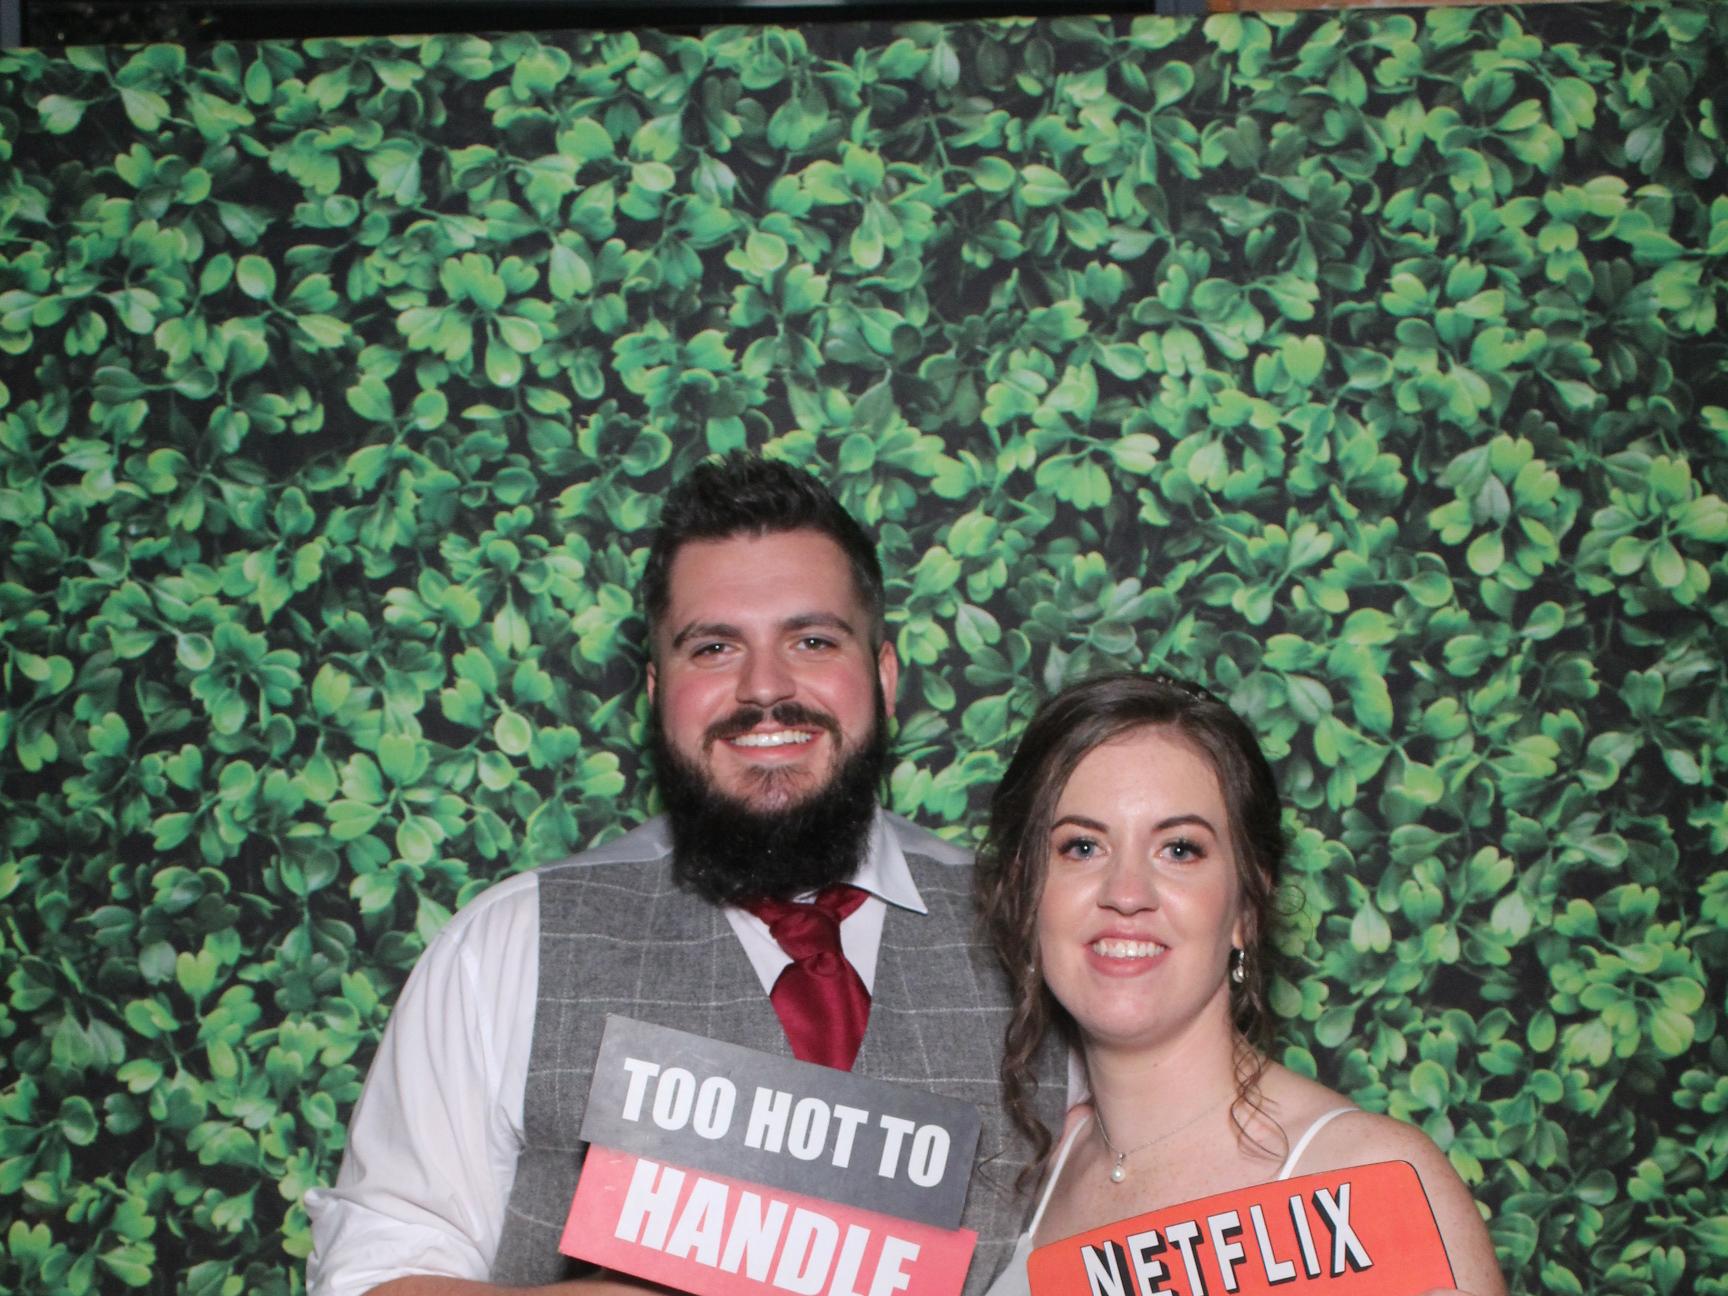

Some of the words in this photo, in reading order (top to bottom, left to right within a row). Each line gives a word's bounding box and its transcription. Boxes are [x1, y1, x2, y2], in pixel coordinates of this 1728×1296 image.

[622, 1057, 737, 1140] TOO
[744, 1086, 869, 1168] HOT
[878, 1114, 951, 1188] TO
